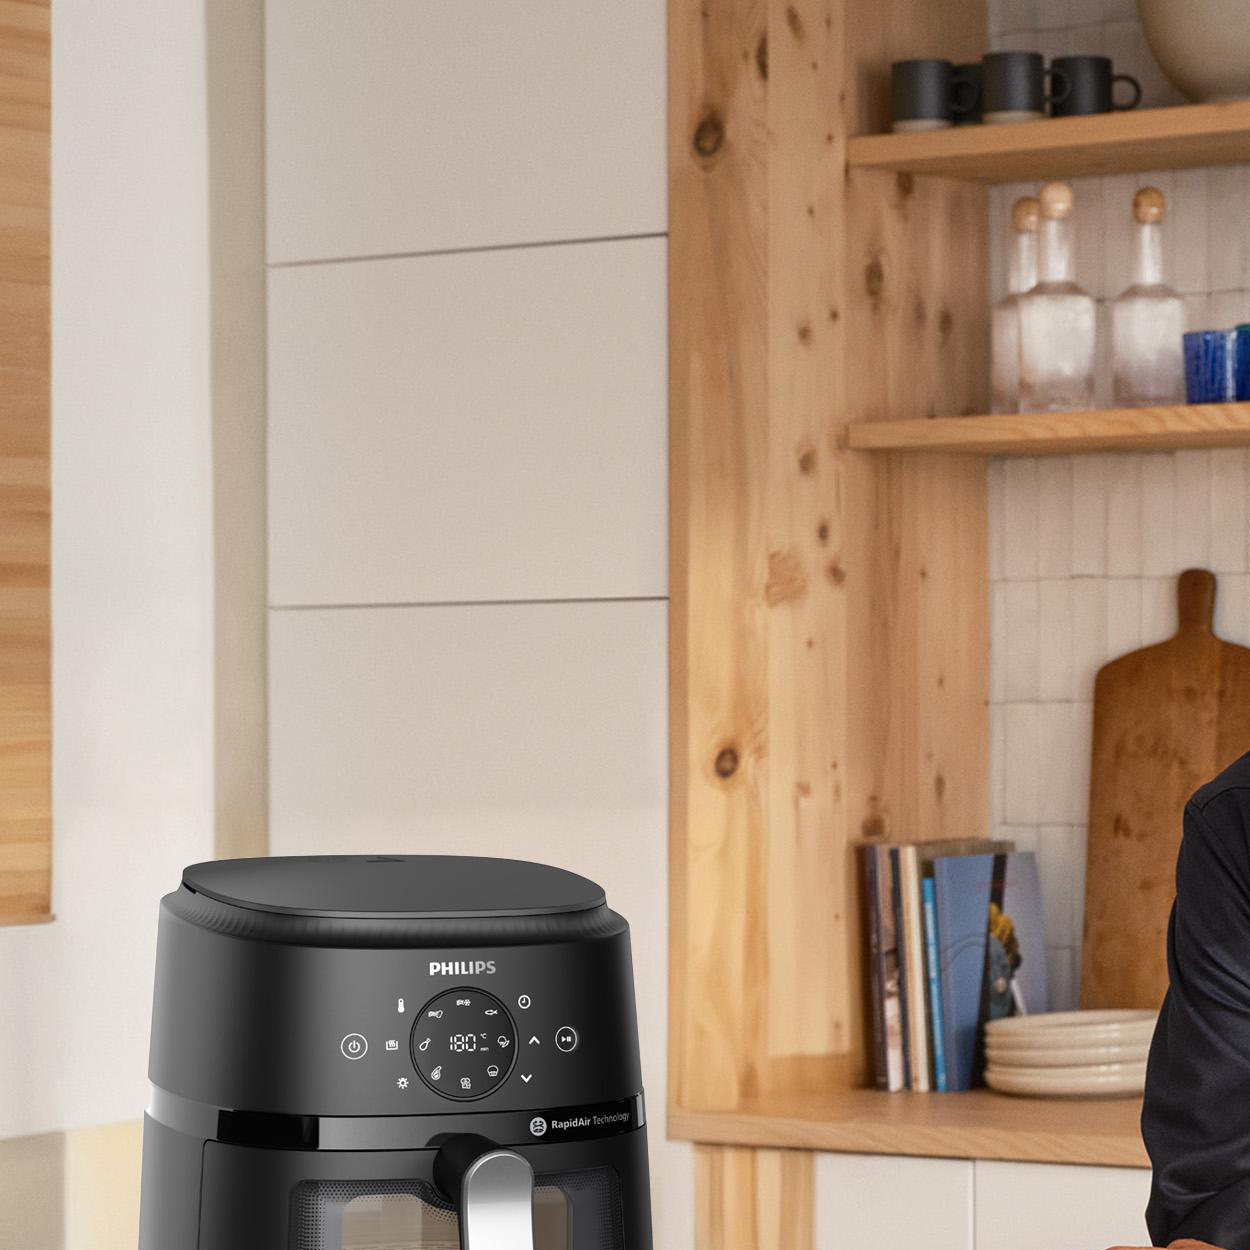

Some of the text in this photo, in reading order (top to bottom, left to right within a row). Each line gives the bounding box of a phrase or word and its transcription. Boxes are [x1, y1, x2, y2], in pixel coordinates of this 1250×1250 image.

[428, 960, 497, 977] PHILIPS
[449, 1033, 477, 1052] 180
[551, 1112, 630, 1130] RapidAir Technology
